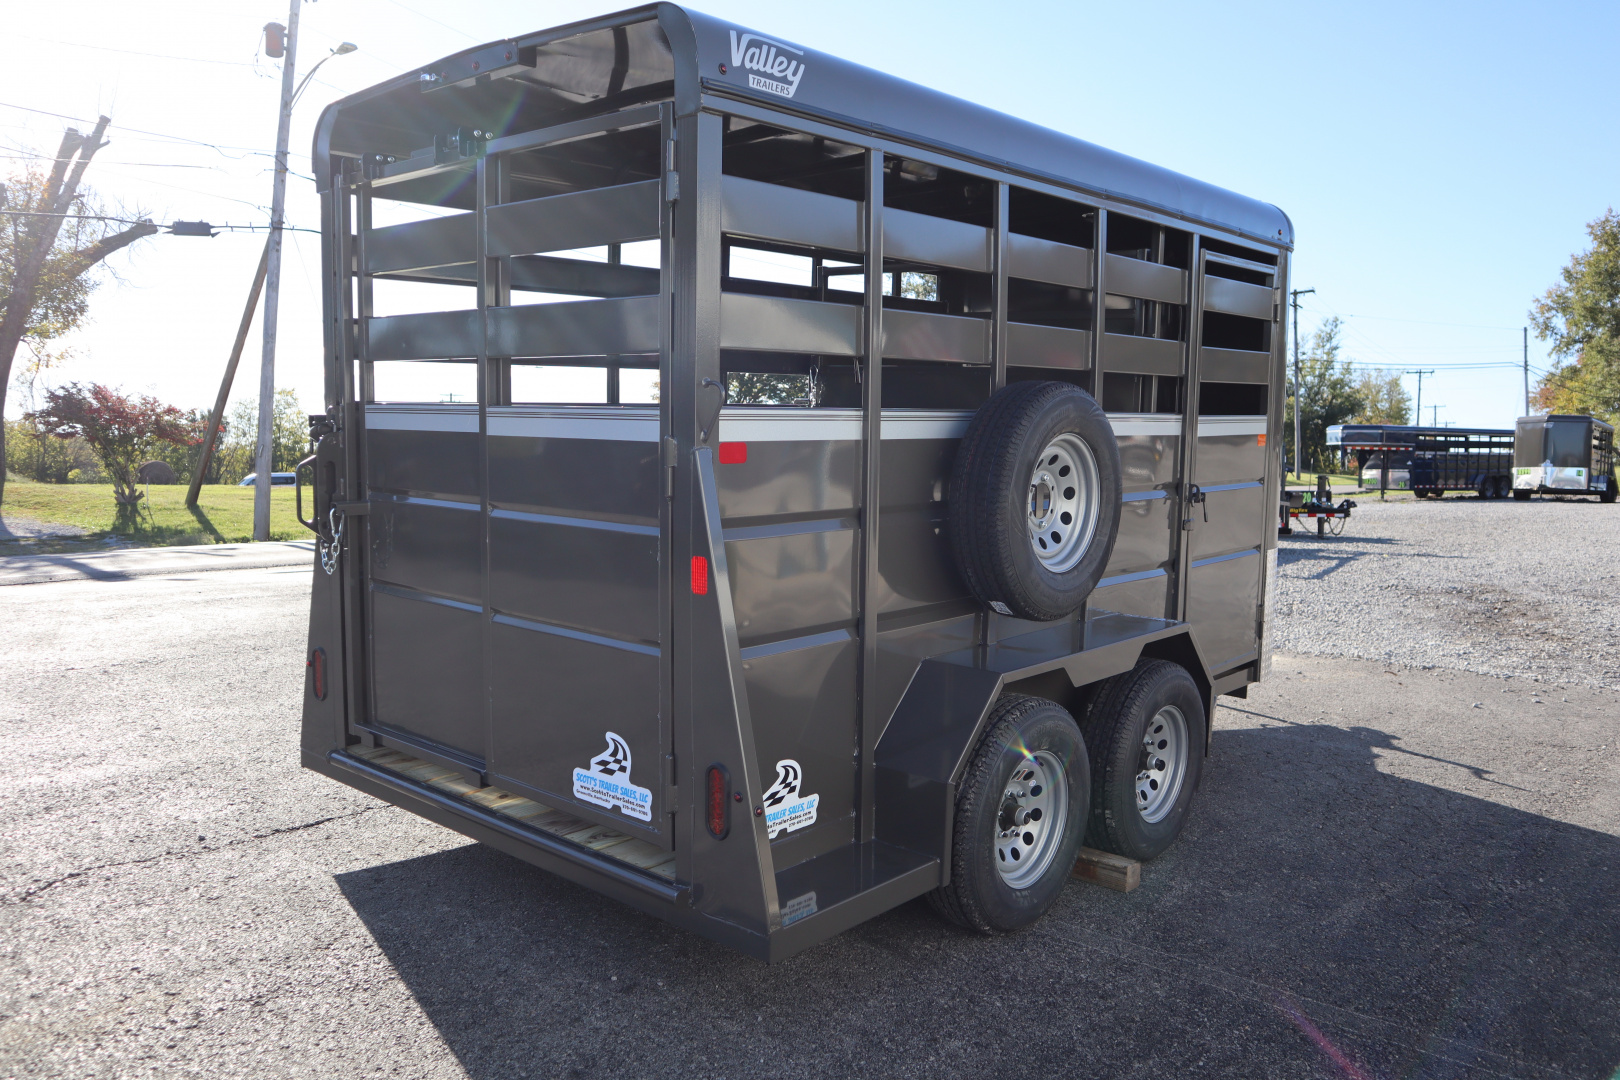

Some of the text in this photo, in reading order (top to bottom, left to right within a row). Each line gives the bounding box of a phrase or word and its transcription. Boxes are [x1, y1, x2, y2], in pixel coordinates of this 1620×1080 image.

[730, 30, 805, 98] Valley
[751, 76, 790, 97] TRAILERS
[1303, 492, 1311, 503] 20
[576, 772, 648, 803] SCOTT'S TRAILER SALES, LLC
[766, 799, 816, 823] TRAILER SALES, LLC
